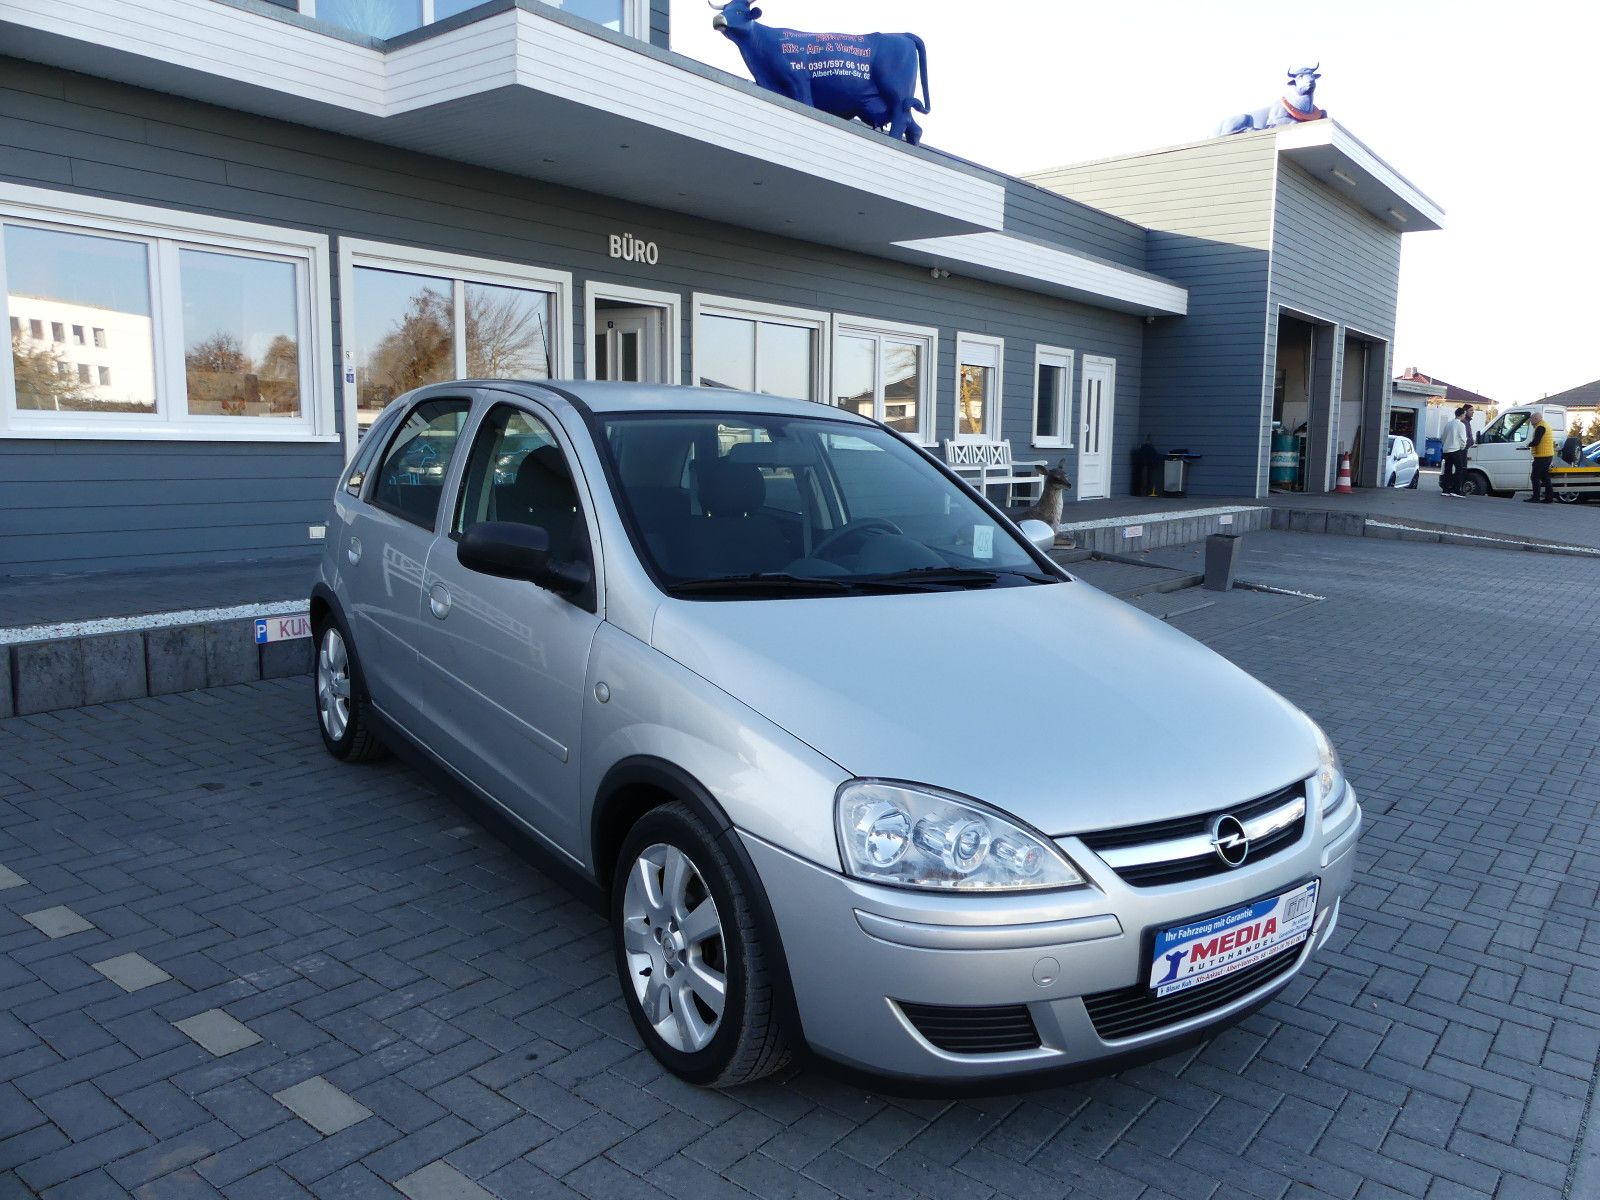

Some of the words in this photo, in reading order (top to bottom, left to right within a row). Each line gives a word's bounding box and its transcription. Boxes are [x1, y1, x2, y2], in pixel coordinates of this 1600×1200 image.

[782, 43, 799, 54] Kfz
[826, 42, 834, 52] &
[835, 43, 871, 58] Verkauf
[790, 62, 806, 71] Tel.
[808, 60, 844, 71] 0391/597
[857, 62, 870, 72] 100
[609, 232, 659, 265] BÜRO
[256, 624, 267, 639] P
[1165, 931, 1177, 942] Ihr
[1178, 923, 1213, 939] Fahrzeug
[1213, 918, 1226, 929] mit
[1226, 908, 1253, 924] Garantie
[1189, 916, 1277, 964] MEDIA
[1188, 936, 1275, 973] AUTOHANDEL
